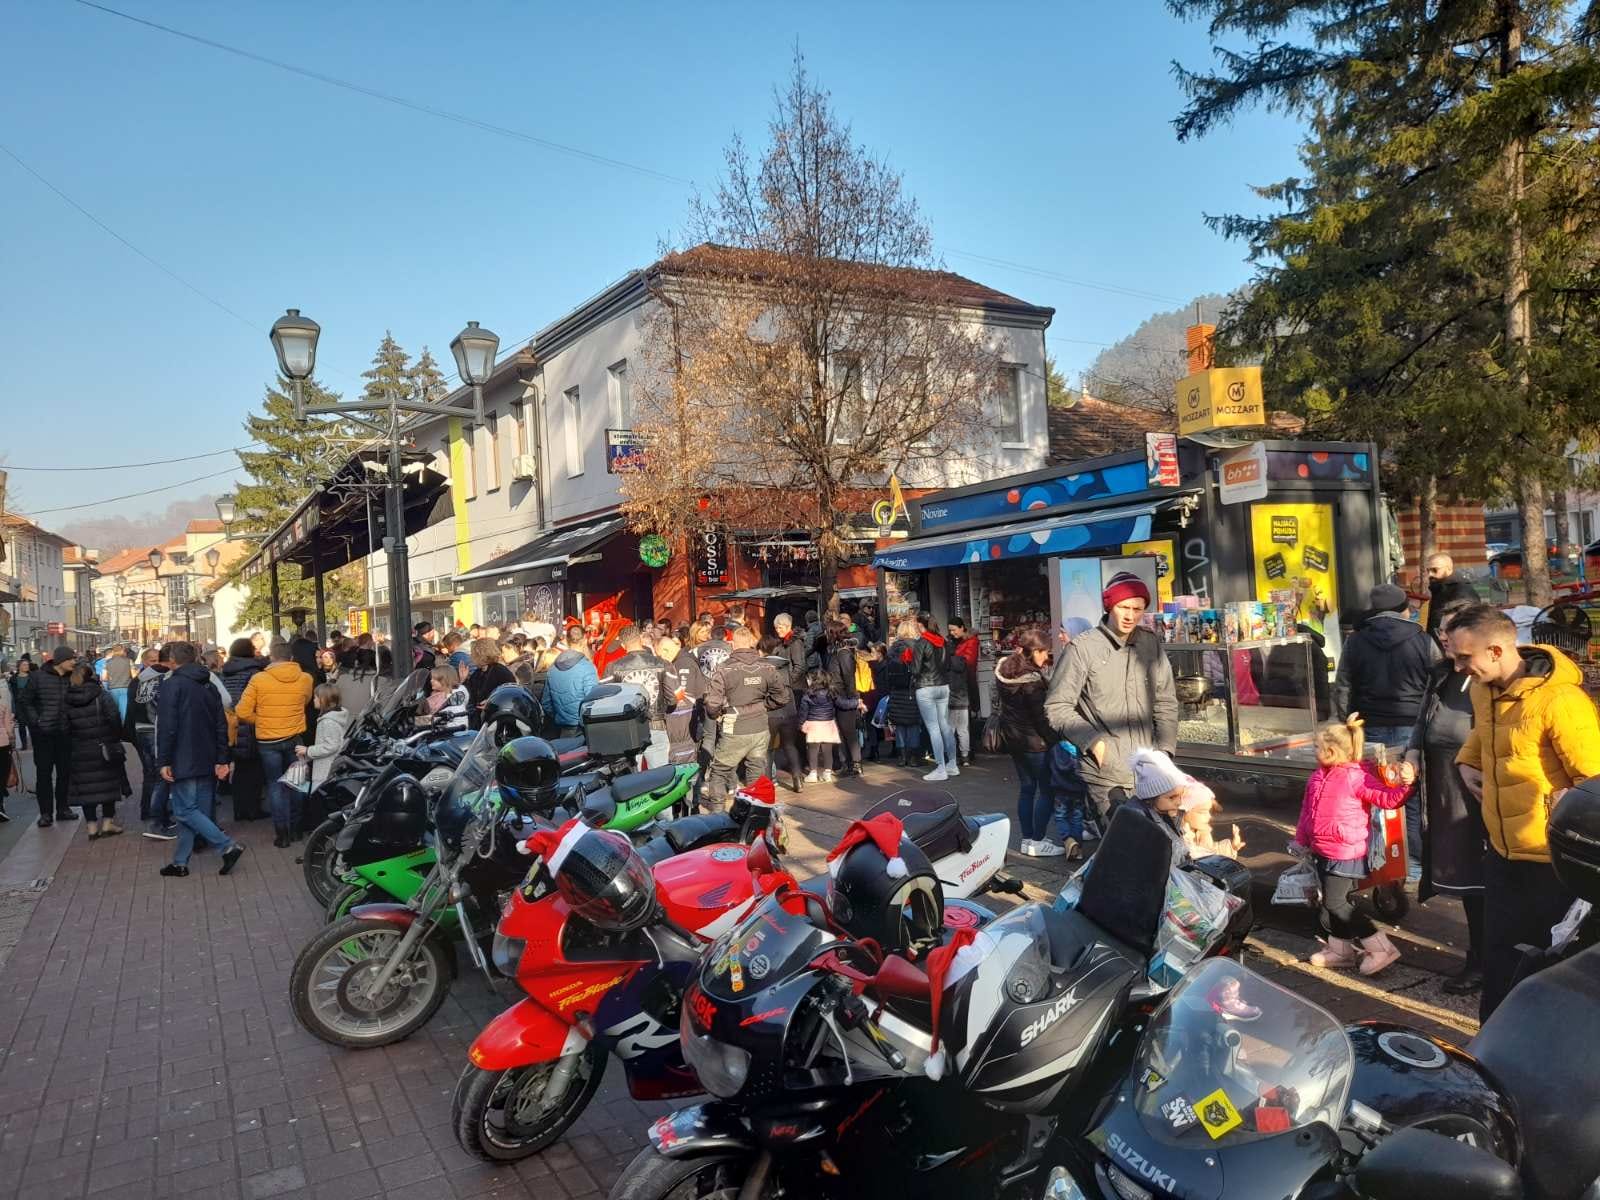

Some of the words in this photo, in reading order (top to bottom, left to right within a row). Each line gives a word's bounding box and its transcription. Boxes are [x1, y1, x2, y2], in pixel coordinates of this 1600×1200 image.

[1181, 408, 1210, 423] MOZZART
[1216, 405, 1260, 415] MOZZART
[549, 980, 584, 998] HONDA
[1020, 986, 1083, 1048] SHARK
[1107, 1133, 1176, 1193] SUZUKI
